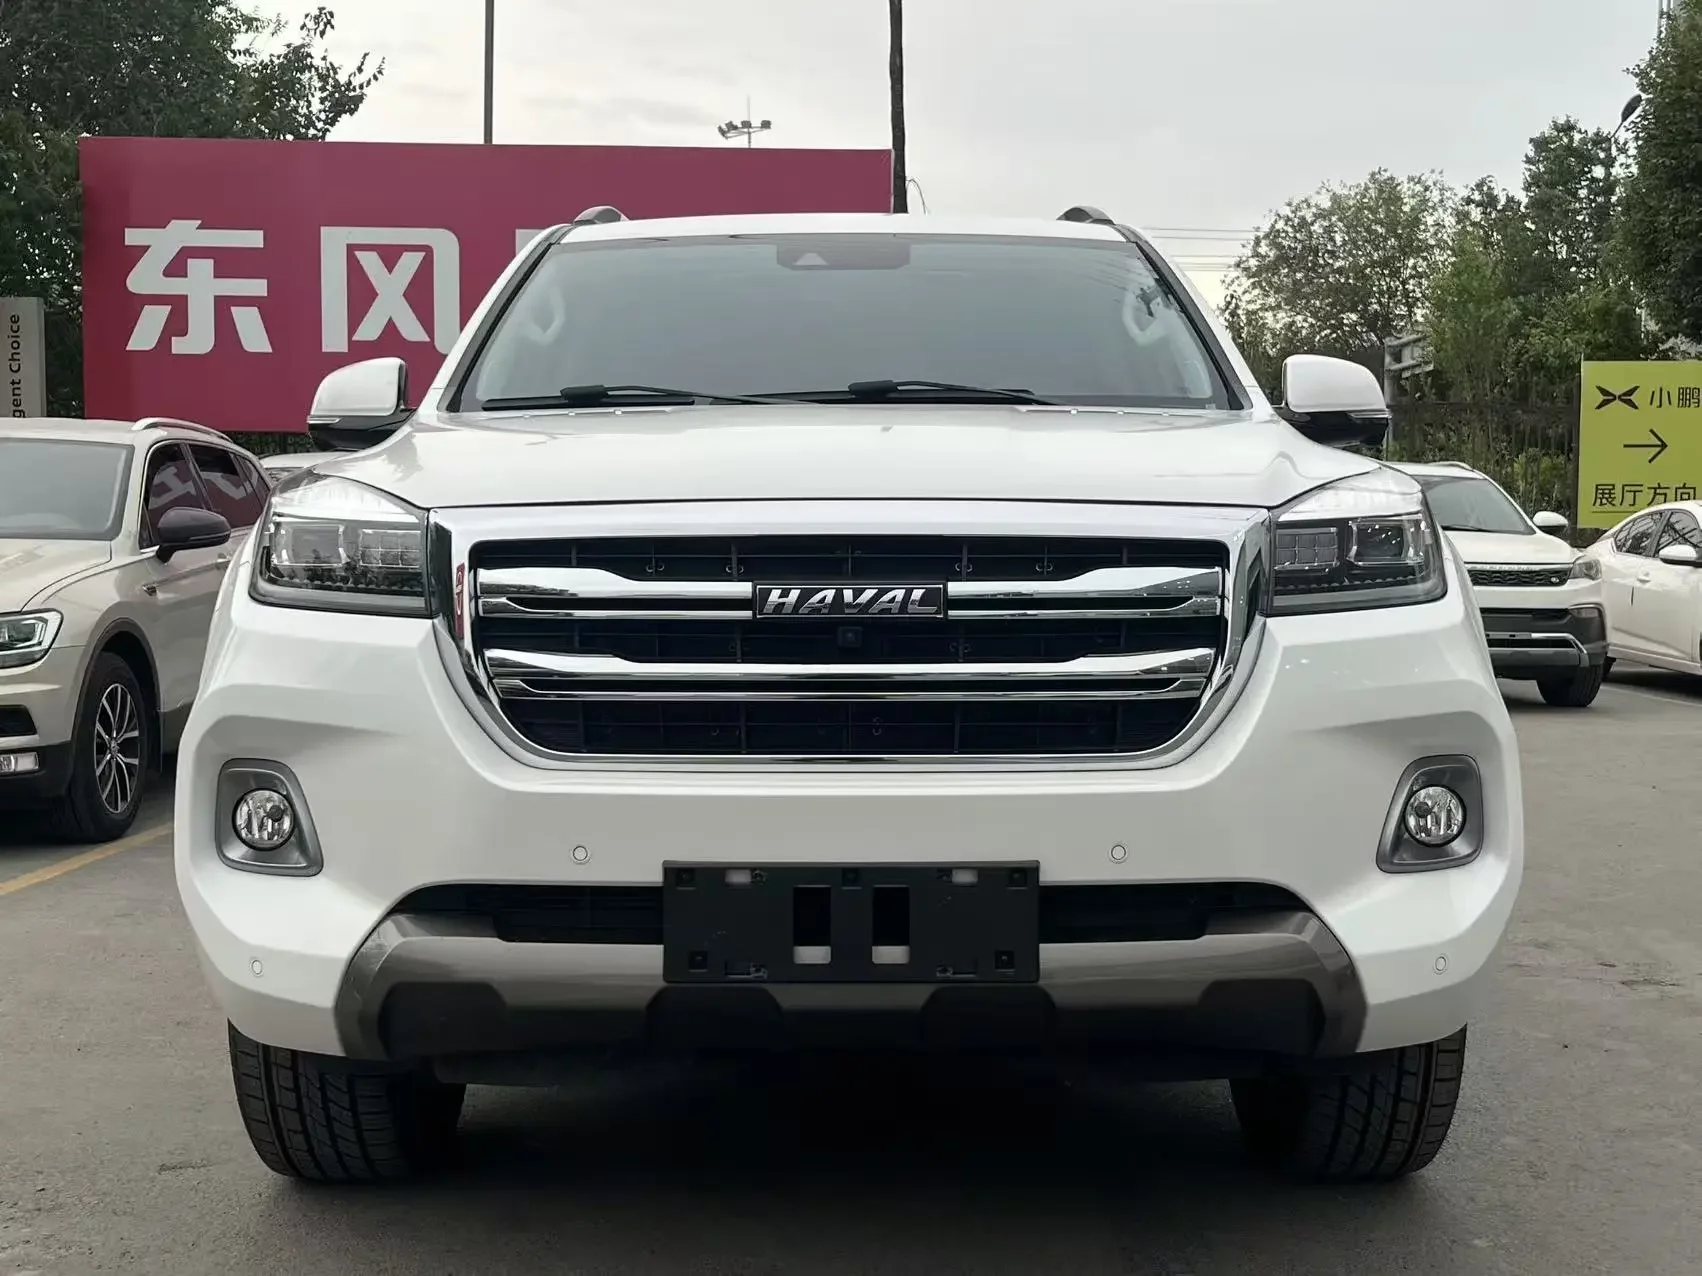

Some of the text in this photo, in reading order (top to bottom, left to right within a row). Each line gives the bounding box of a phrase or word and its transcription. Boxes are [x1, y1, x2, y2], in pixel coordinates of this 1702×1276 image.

[124, 219, 546, 355] 东风
[7, 314, 21, 373] Choice
[1649, 386, 1701, 409] 小鹏
[1592, 482, 1697, 507] 展厅方向
[763, 588, 938, 614] HAVAL
